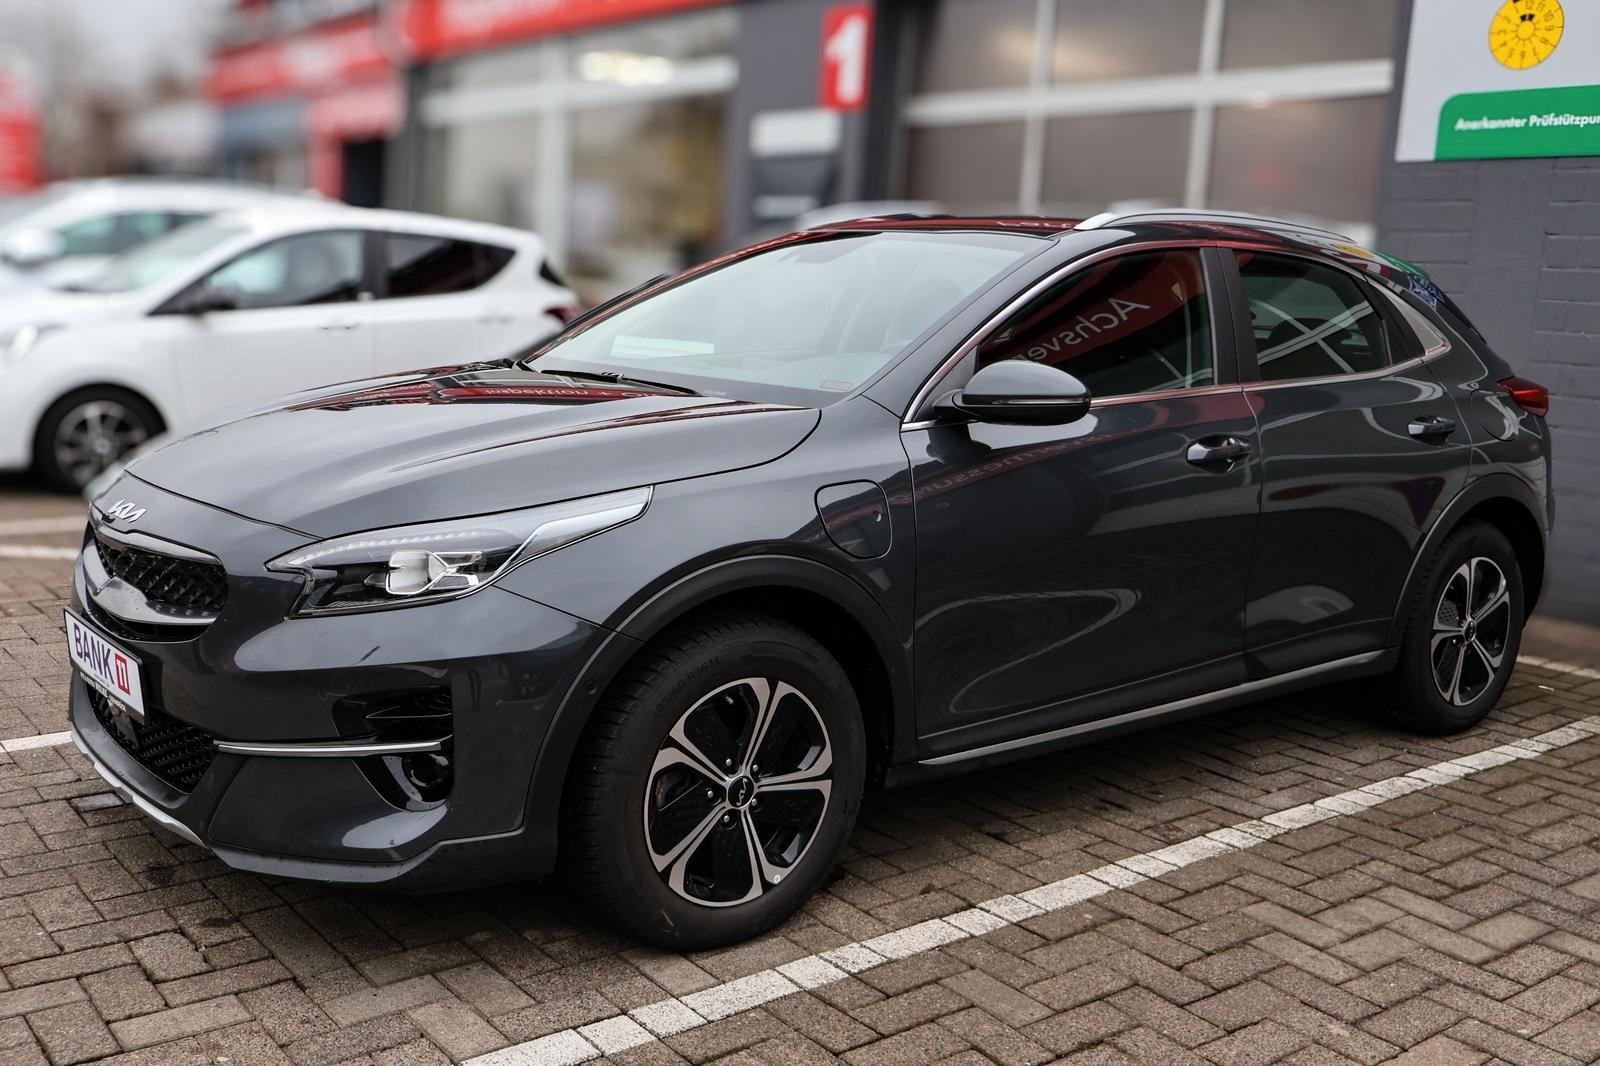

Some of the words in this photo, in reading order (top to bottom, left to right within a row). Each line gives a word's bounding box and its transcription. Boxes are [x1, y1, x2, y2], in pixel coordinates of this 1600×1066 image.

[1525, 0, 1534, 10] 12
[1543, 10, 1554, 22] 10
[825, 14, 868, 102] 1
[1454, 116, 1527, 131] Anerkannter
[107, 499, 148, 523] KIA
[73, 622, 115, 685] BANK
